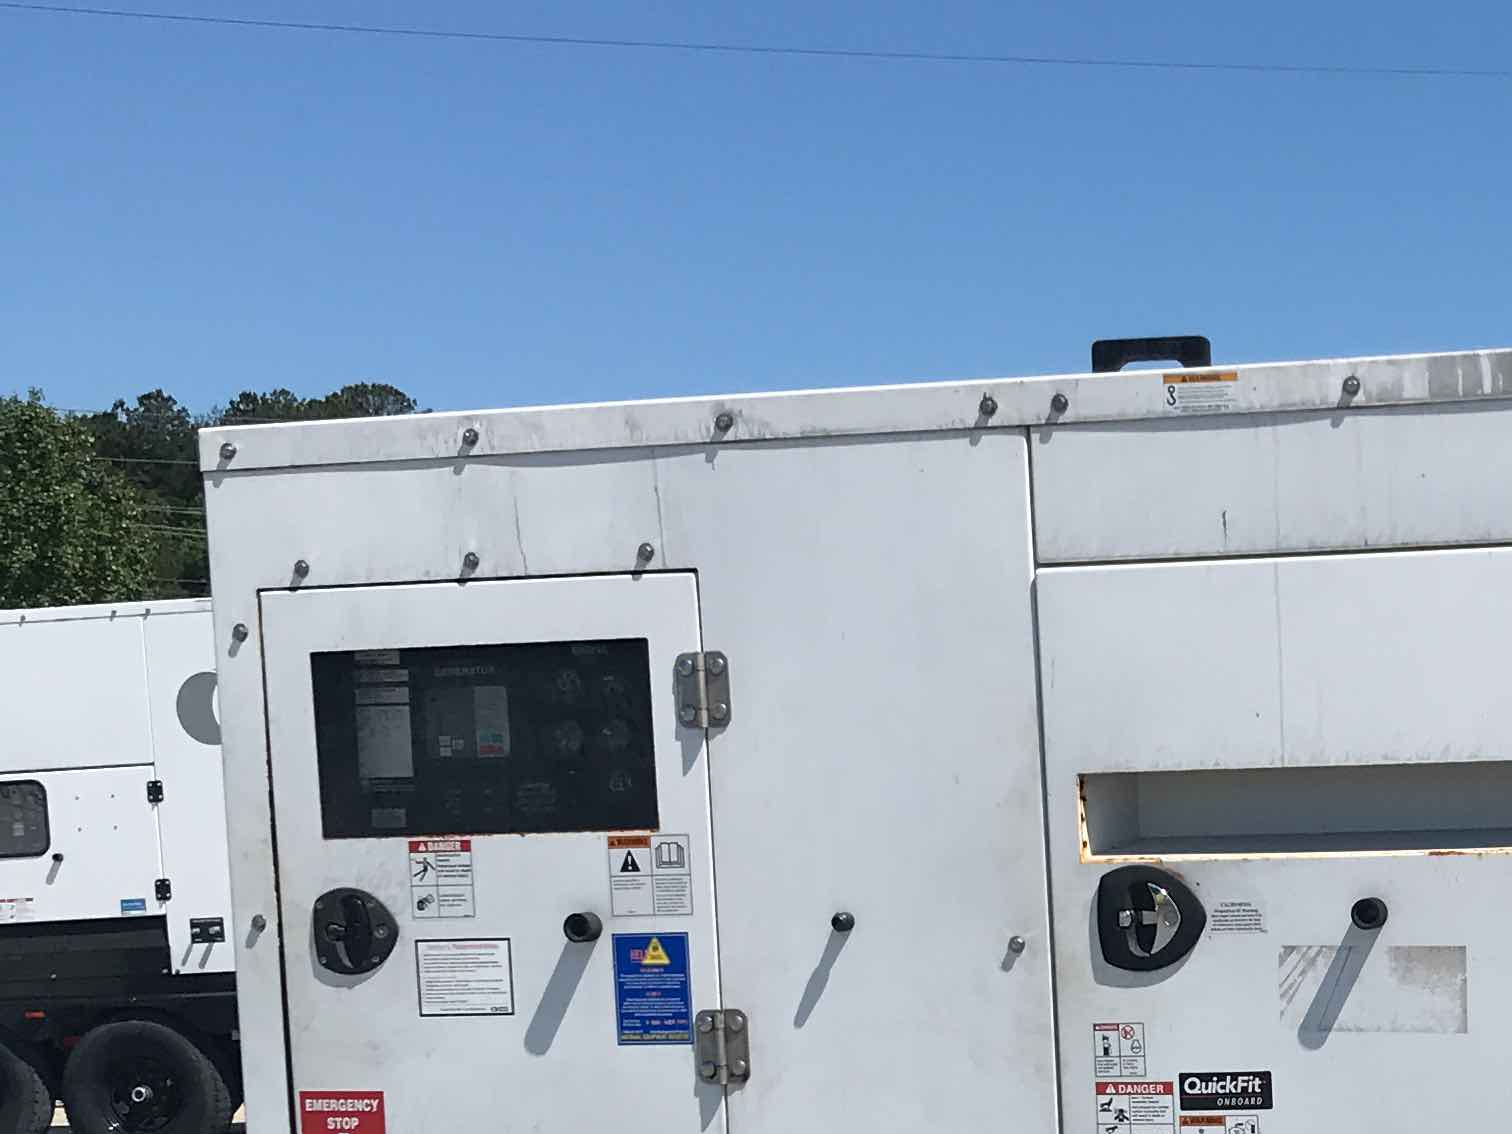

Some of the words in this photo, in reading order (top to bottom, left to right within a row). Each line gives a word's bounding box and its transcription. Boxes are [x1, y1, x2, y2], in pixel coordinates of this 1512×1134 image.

[1118, 1084, 1164, 1094] DANGER
[1184, 1075, 1262, 1095] QuickFit
[305, 1098, 380, 1113] EMERGENCY
[1217, 1097, 1263, 1106] ONBOARD
[327, 1117, 359, 1130] STOP
